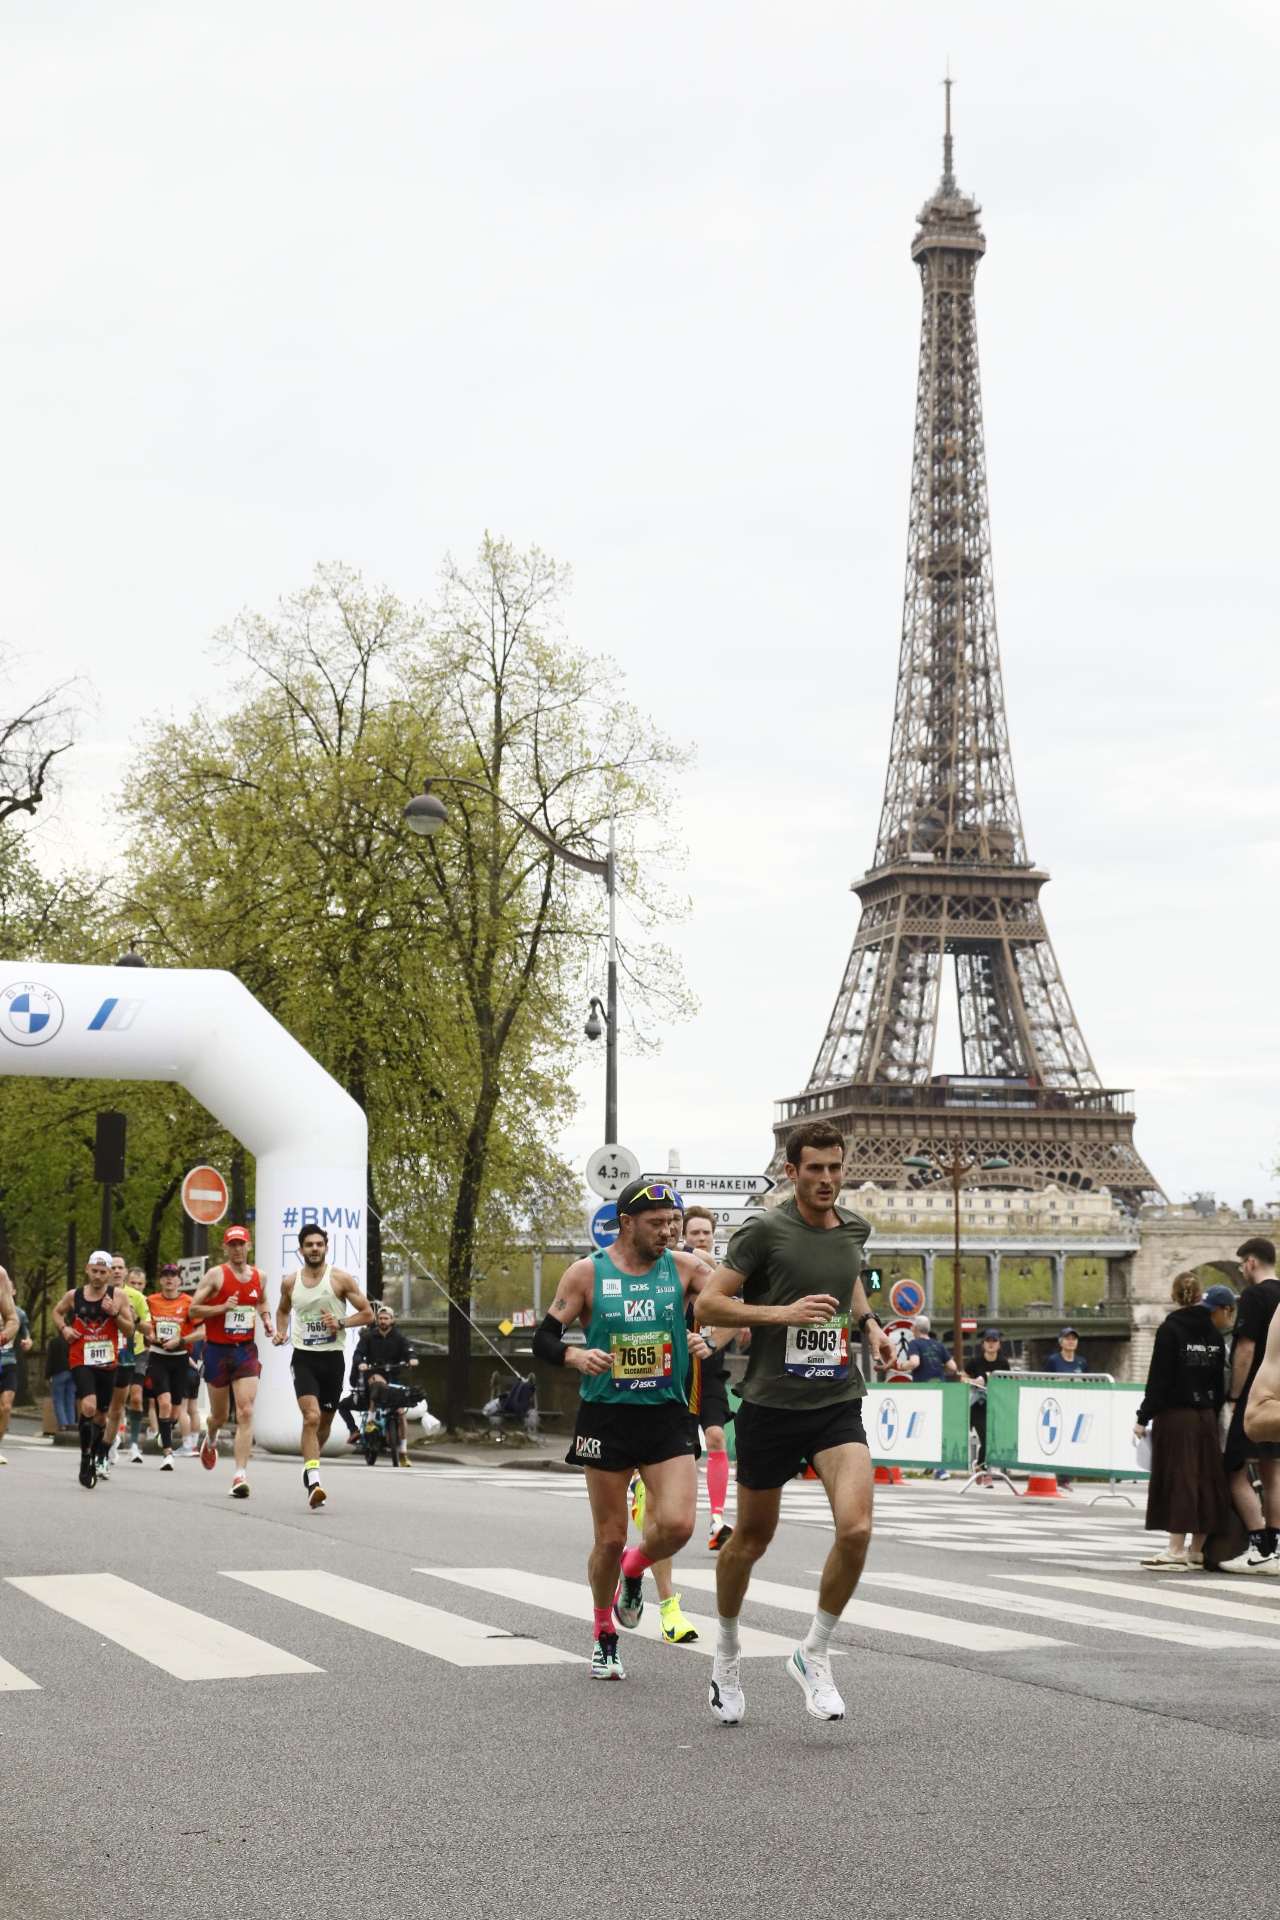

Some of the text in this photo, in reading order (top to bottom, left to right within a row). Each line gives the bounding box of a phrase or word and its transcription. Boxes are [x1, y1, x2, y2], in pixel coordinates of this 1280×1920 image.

[5, 984, 54, 1001] BMW
[597, 1165, 630, 1179] 4.3 m
[685, 1178, 757, 1190] BIR-HAKEIM
[282, 1206, 361, 1229] #BMW
[623, 1299, 656, 1317] DKR
[233, 1312, 245, 1322] 715
[622, 1332, 660, 1342] Schneider
[796, 1329, 837, 1352] 6903
[619, 1346, 656, 1366] 7665
[807, 1356, 825, 1364] Simon
[624, 1367, 652, 1375] CECCARELLI
[814, 1368, 834, 1377] asics
[638, 1380, 657, 1388] asics
[576, 1435, 601, 1455] DKR
